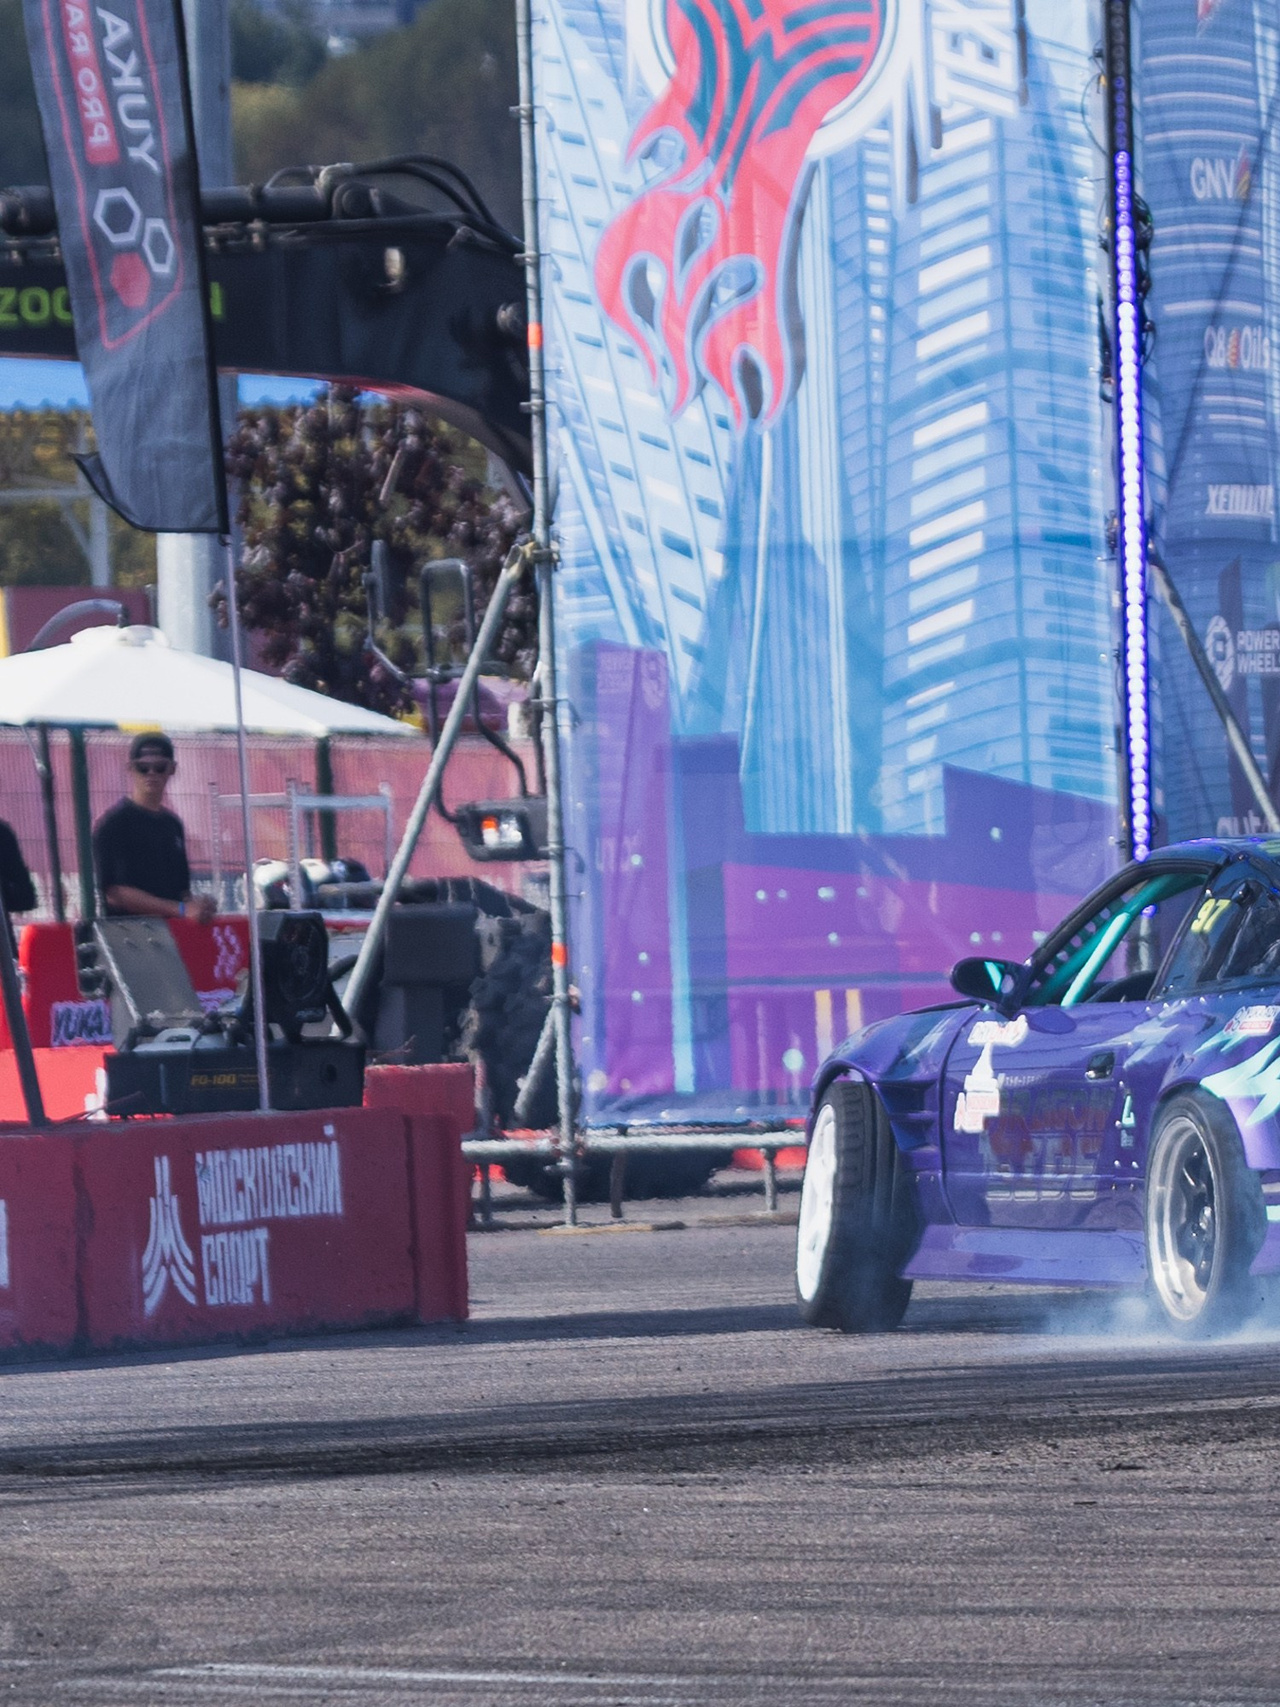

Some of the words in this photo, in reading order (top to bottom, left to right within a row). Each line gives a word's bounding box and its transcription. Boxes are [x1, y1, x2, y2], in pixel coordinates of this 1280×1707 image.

[1237, 630, 1280, 651] POWER
[195, 1124, 343, 1225] МОСКОВСКИЙ
[201, 1227, 271, 1306] СПОРТ
